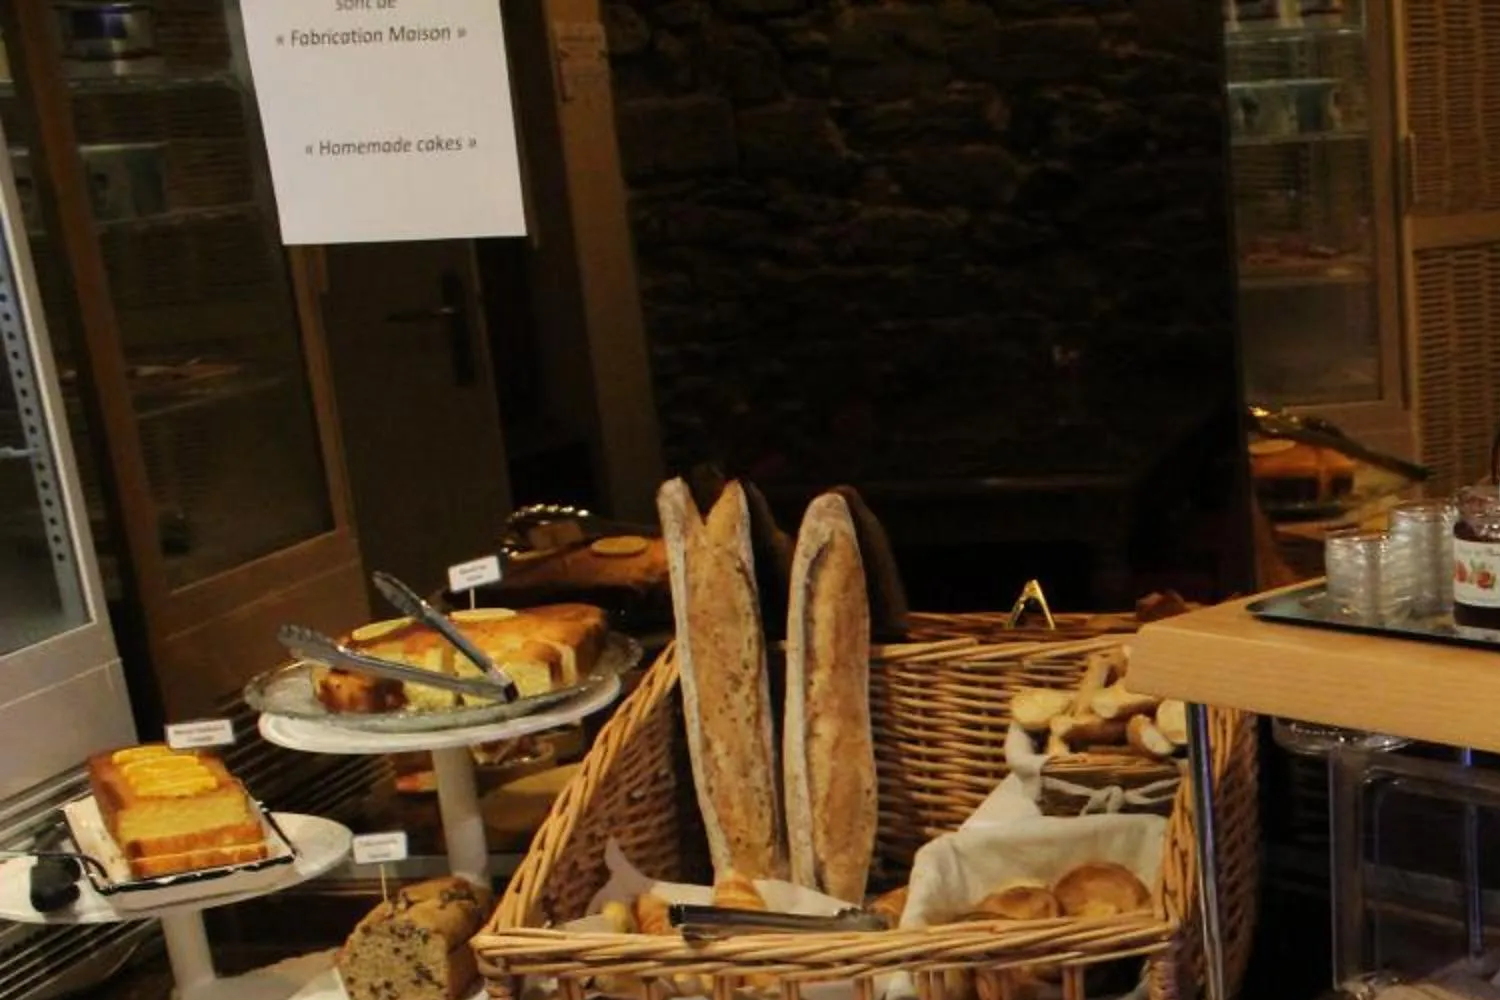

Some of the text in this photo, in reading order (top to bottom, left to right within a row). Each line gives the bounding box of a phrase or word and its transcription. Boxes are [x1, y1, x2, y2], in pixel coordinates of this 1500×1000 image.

[290, 26, 383, 47] Fabrication
[389, 24, 451, 42] Maison
[319, 137, 412, 156] Homemade
[416, 135, 462, 152] cakes
